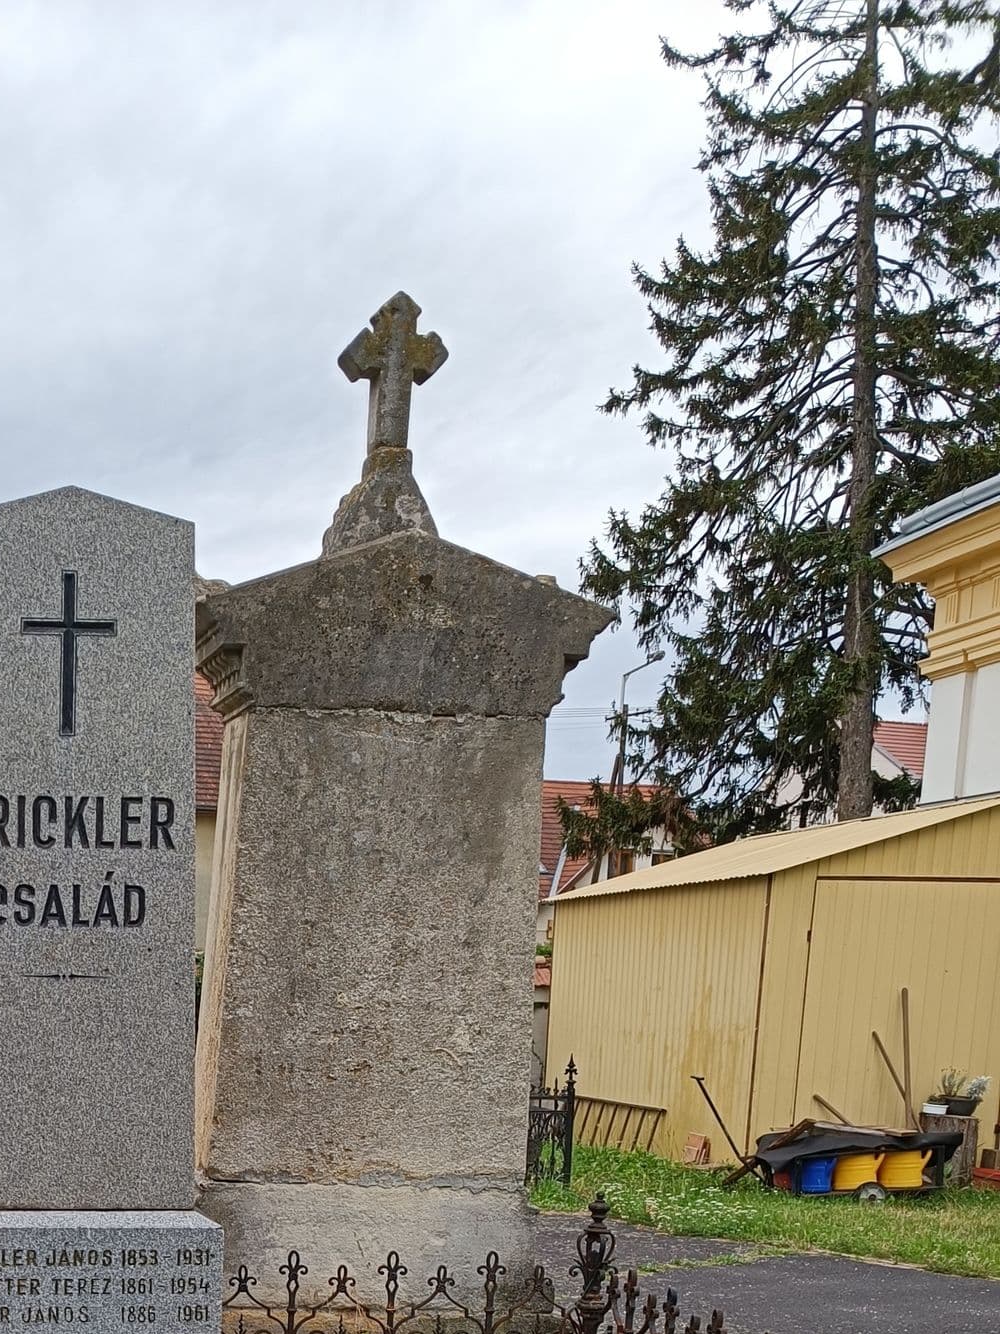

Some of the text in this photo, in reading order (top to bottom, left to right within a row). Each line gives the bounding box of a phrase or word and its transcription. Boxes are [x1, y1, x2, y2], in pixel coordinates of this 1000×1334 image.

[121, 1249, 158, 1267] 1853
[51, 1272, 111, 1295] TERÉZ
[121, 1278, 153, 1295] 1861
[171, 1277, 210, 1295] 1954
[121, 1306, 156, 1324] 1886
[177, 1305, 209, 1323] 1961
